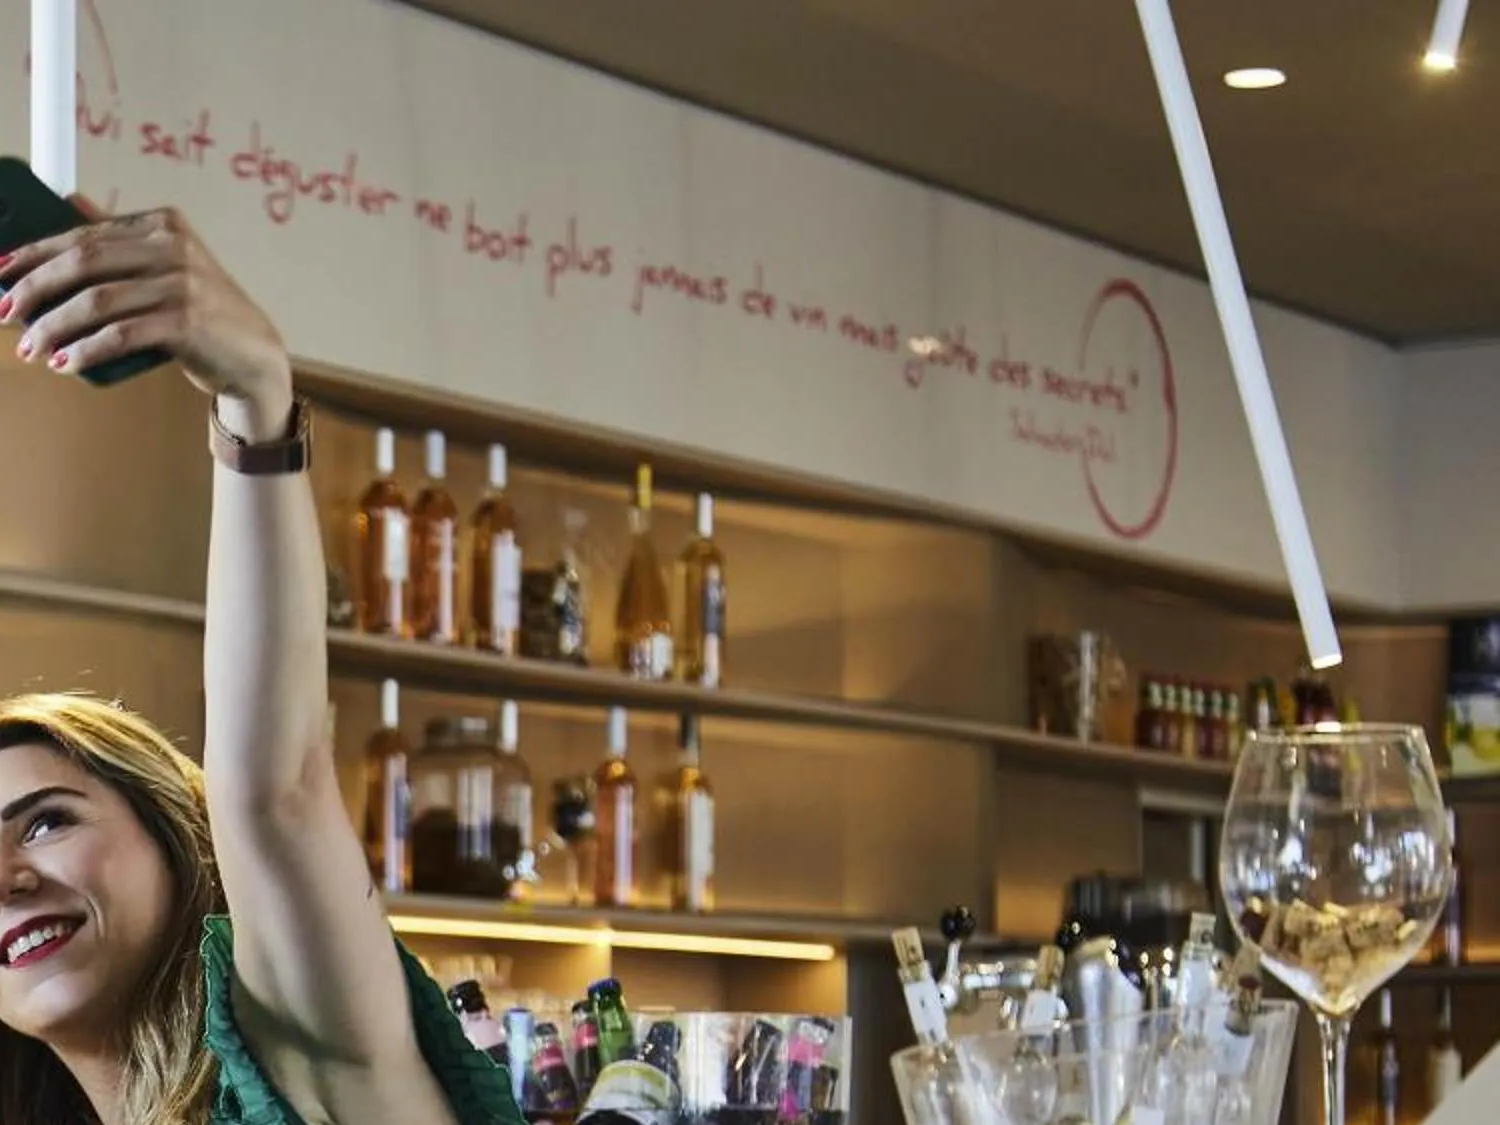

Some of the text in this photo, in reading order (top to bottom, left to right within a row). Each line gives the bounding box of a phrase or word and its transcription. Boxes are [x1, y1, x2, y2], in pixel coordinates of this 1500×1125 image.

[413, 198, 453, 235] ne
[545, 211, 613, 299] plus
[741, 258, 776, 320] de
[987, 330, 1033, 391] des
